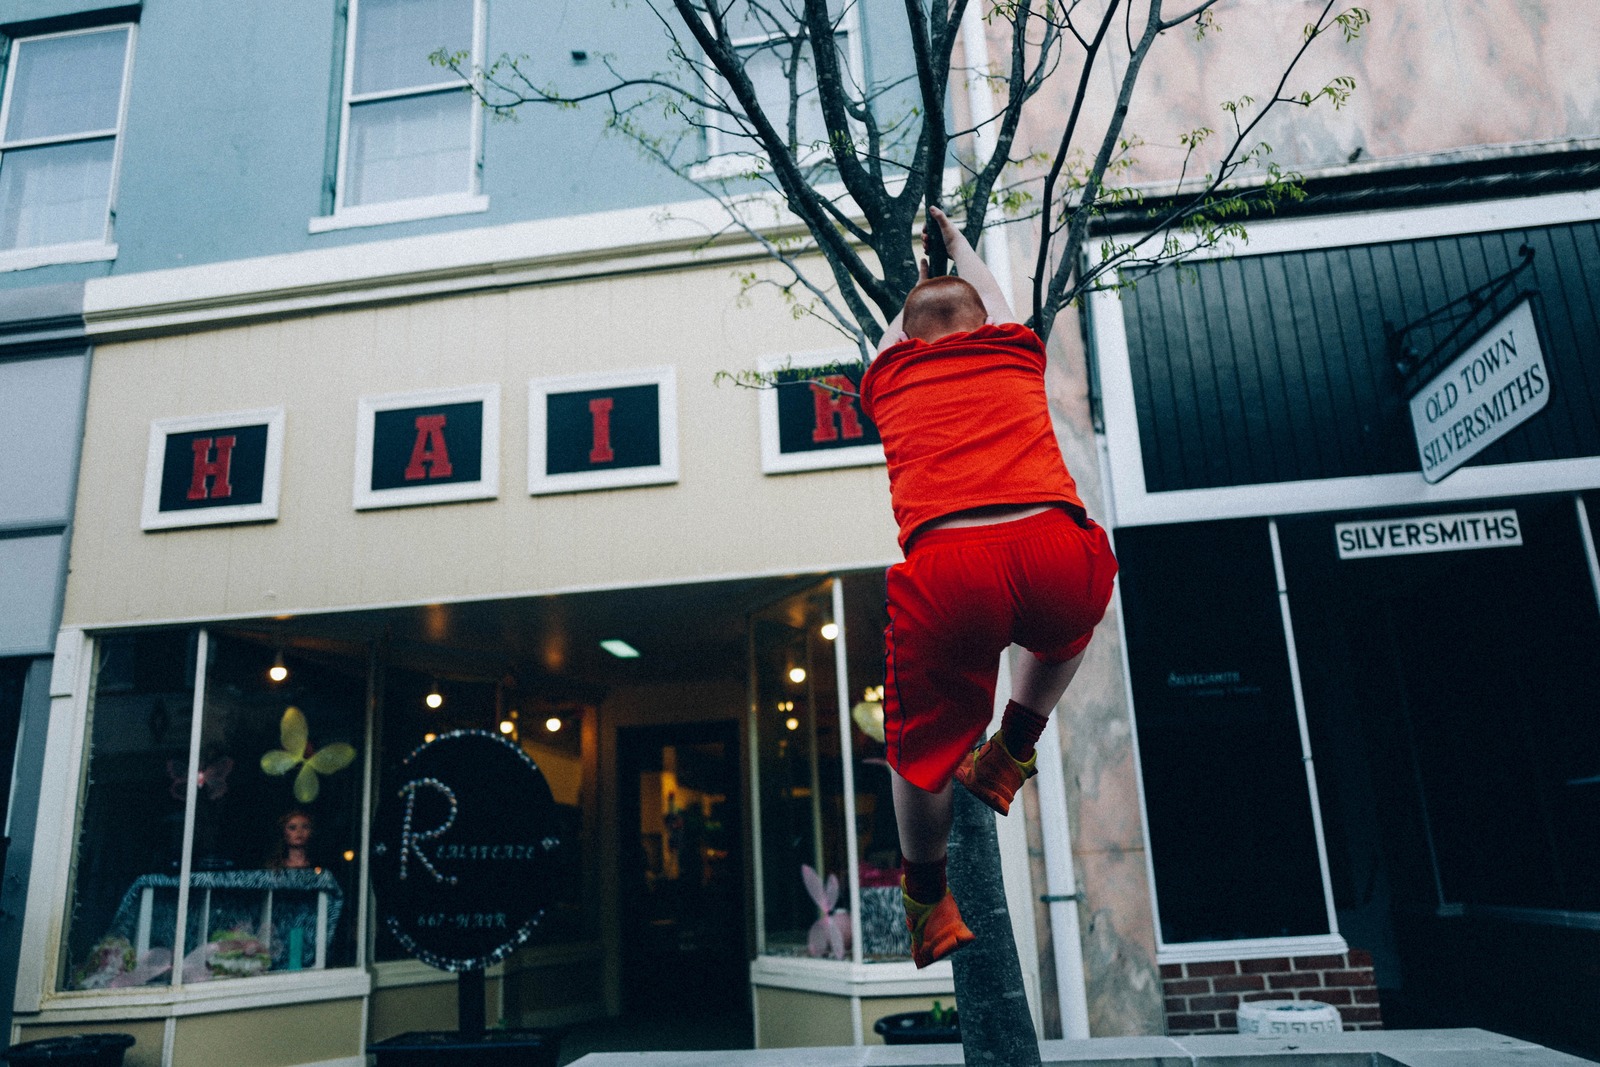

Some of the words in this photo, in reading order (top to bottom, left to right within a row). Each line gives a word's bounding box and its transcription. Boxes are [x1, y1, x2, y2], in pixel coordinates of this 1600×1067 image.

[1424, 364, 1543, 469] SILVERSMITHS
[1425, 382, 1459, 423] OLD
[1461, 330, 1518, 393] TOWN
[1340, 516, 1518, 551] SILVERSMITHS
